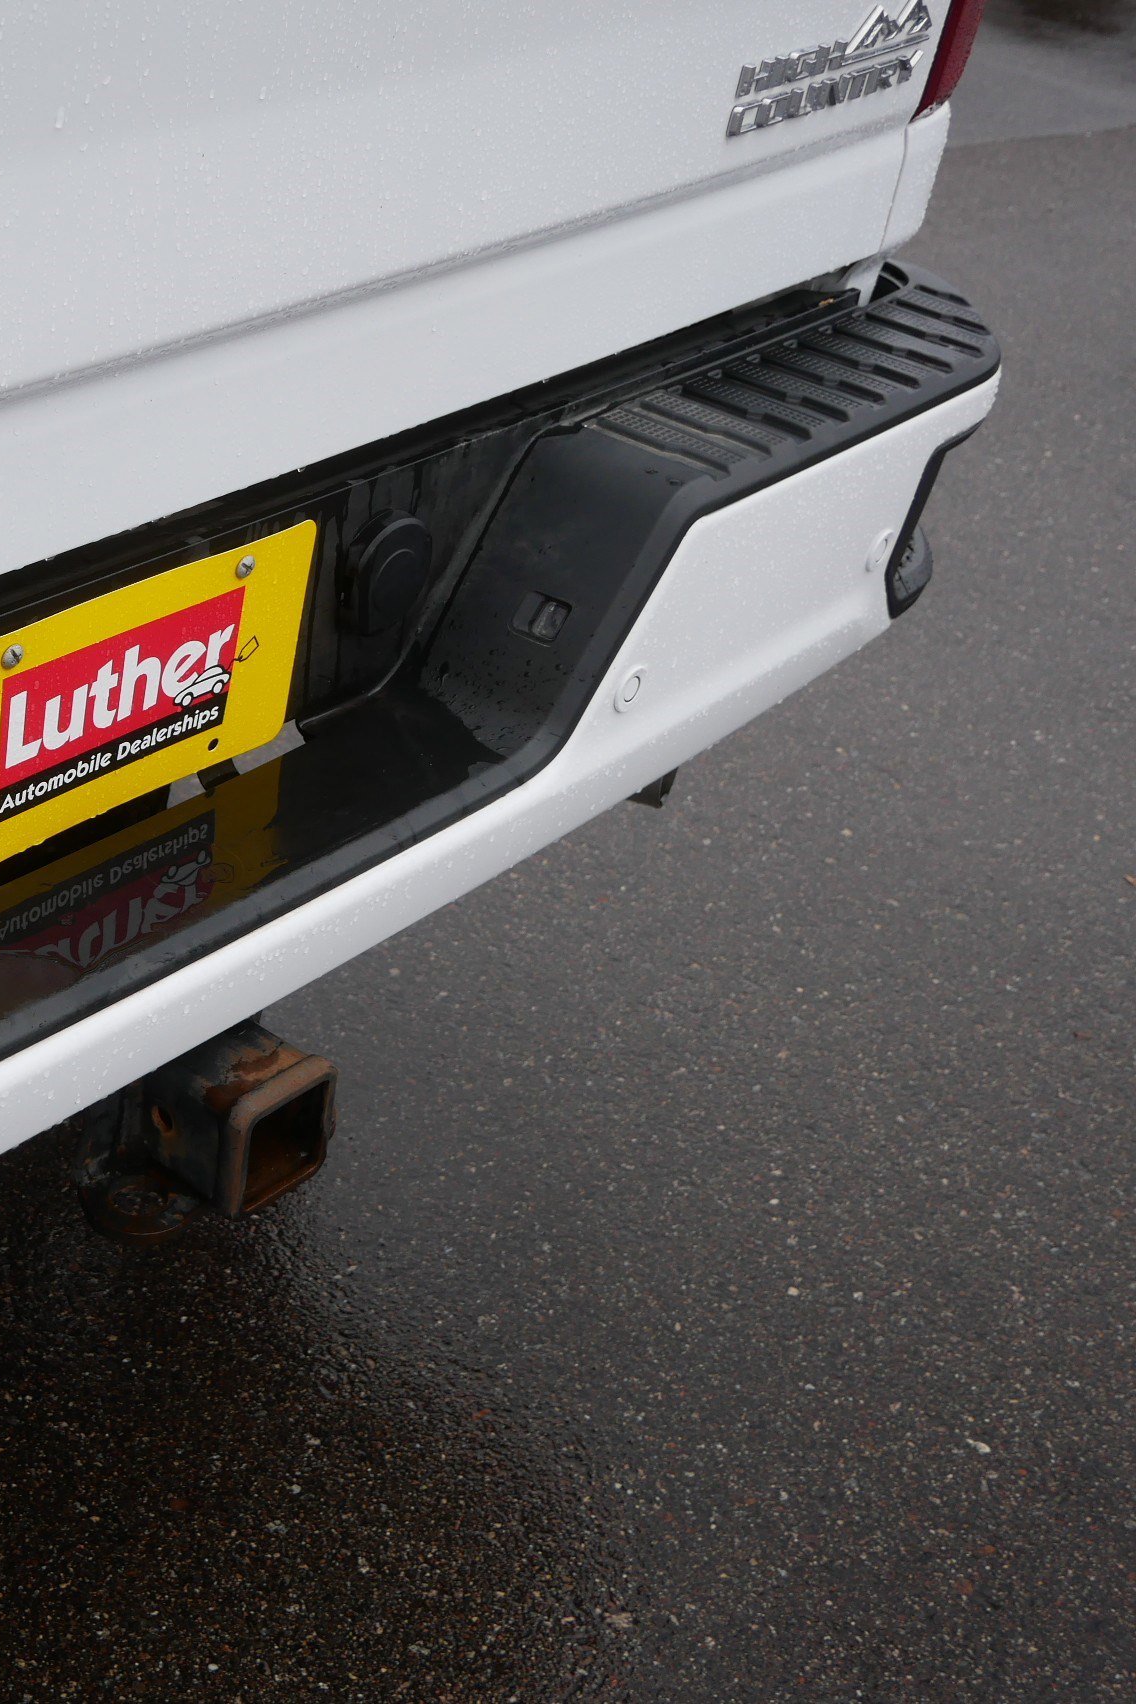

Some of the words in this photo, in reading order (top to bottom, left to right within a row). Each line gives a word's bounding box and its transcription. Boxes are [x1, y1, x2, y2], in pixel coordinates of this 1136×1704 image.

[726, 50, 924, 137] COUNTRY
[735, 39, 848, 98] HIGH
[4, 624, 235, 770] Luther
[0, 750, 111, 814] Automobile
[117, 705, 219, 762] Dealerships
